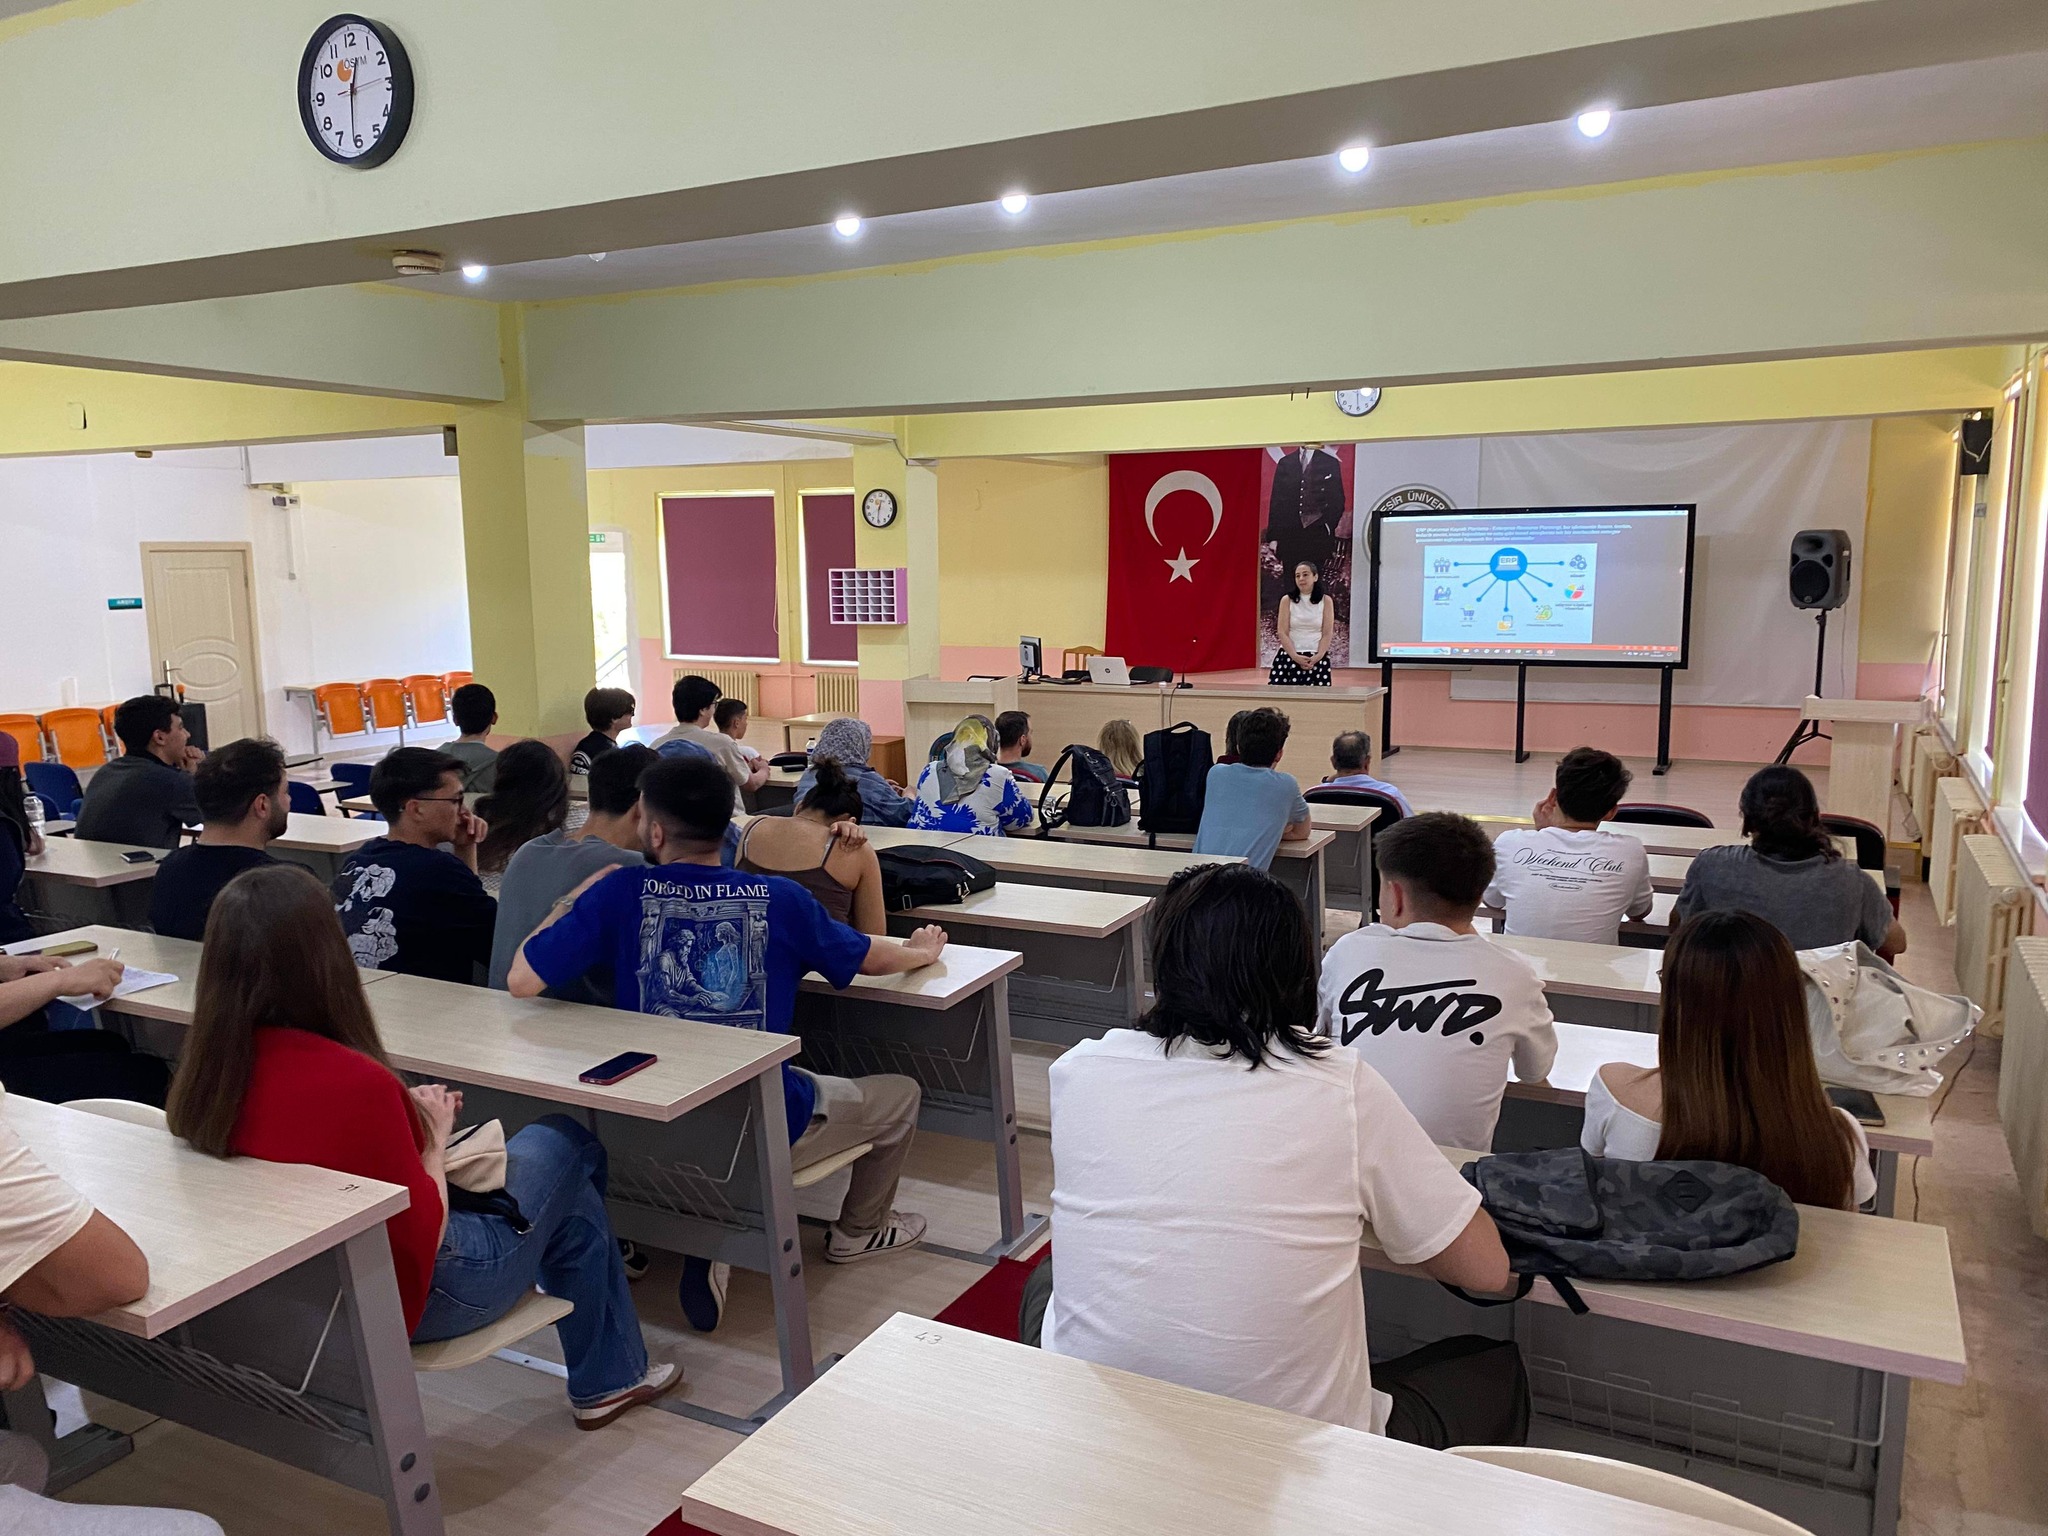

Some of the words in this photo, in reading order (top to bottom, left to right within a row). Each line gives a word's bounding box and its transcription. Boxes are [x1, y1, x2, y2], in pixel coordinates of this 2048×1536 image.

[344, 32, 356, 48] 12
[366, 36, 370, 50] 1
[329, 44, 338, 59] 11
[376, 51, 386, 66] 2
[320, 64, 333, 79] 10
[385, 77, 393, 91] 3
[316, 92, 325, 107] 9
[383, 103, 390, 118] 4
[323, 117, 332, 131] 8
[372, 124, 381, 139] 5
[335, 131, 344, 146] 7
[354, 134, 363, 149] 6
[1407, 490, 1447, 510] ÜNİVER
[1513, 847, 1582, 869] Weekend
[1584, 856, 1625, 873] Club
[694, 884, 712, 900] IN
[716, 884, 770, 898] FLAME
[914, 1331, 943, 1344] 43
